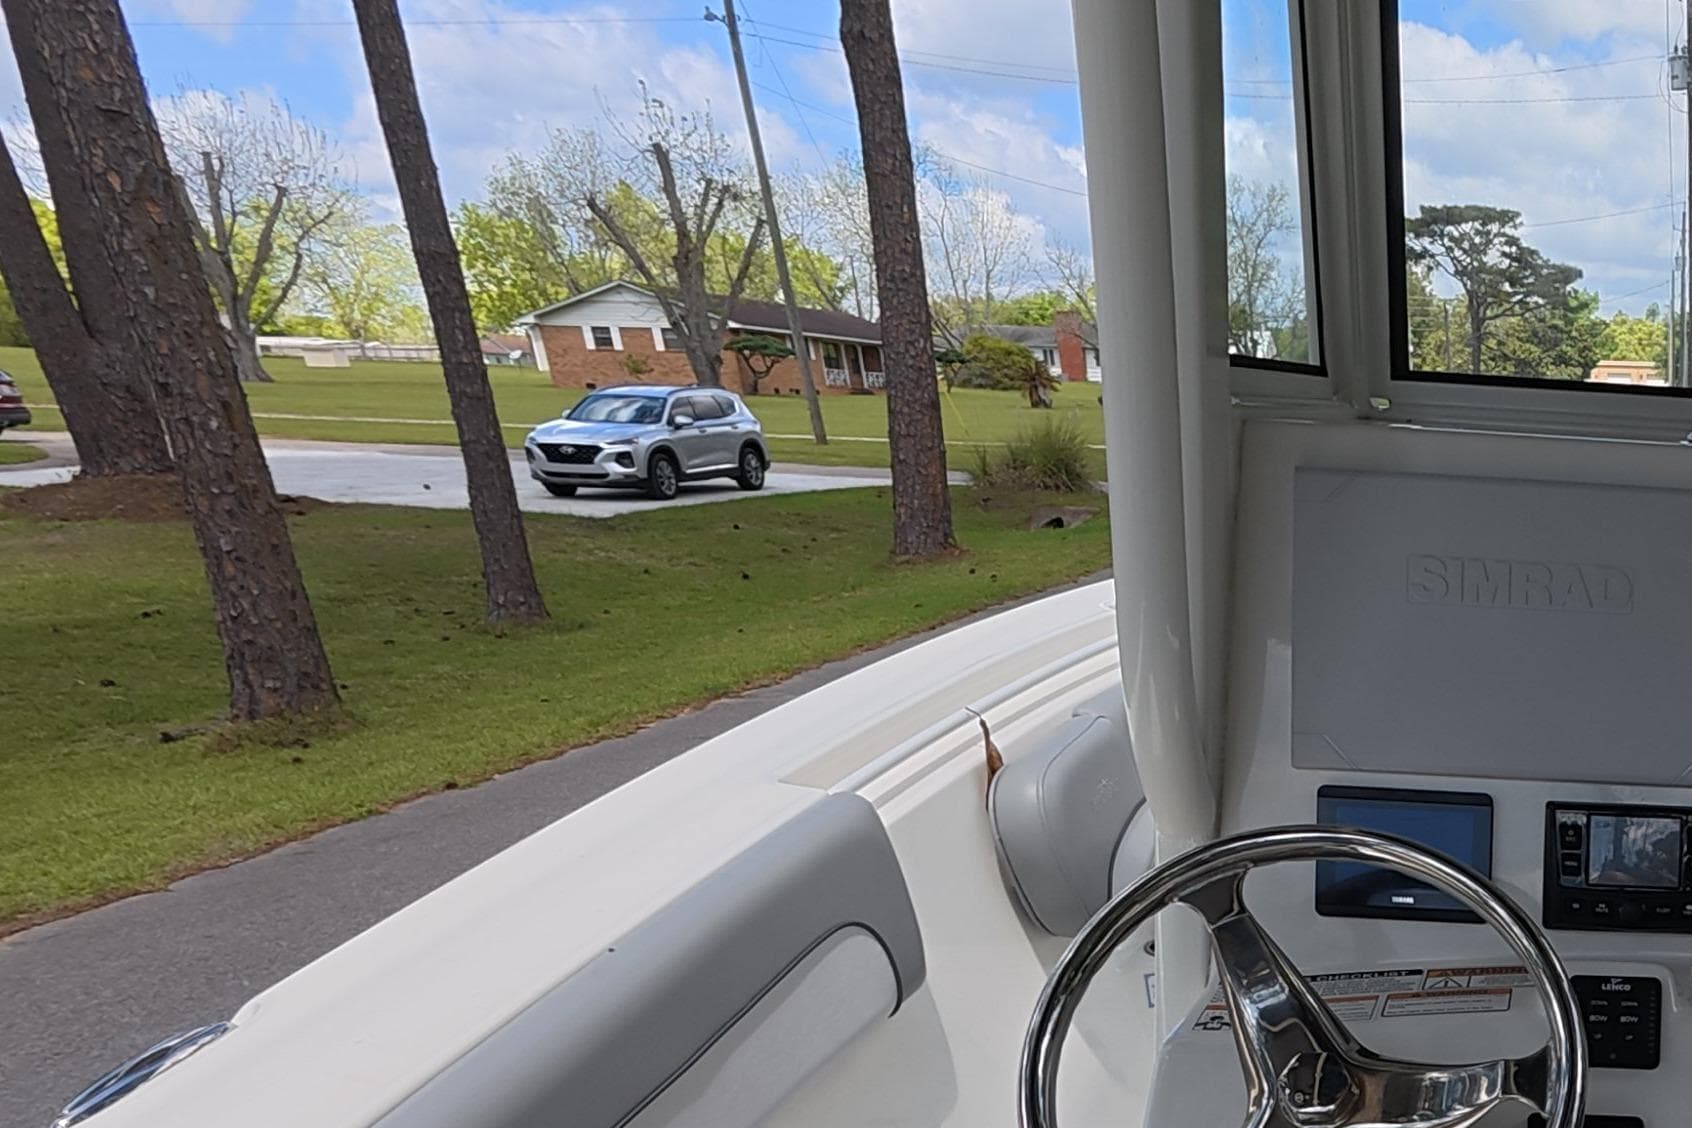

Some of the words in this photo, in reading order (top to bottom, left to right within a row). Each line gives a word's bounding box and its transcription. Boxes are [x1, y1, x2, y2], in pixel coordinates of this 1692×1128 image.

[1407, 554, 1634, 614] SIMRAD
[1316, 970, 1410, 982] CHECKLIST
[1601, 982, 1632, 992] LENCO
[1423, 988, 1489, 998] WARNING
